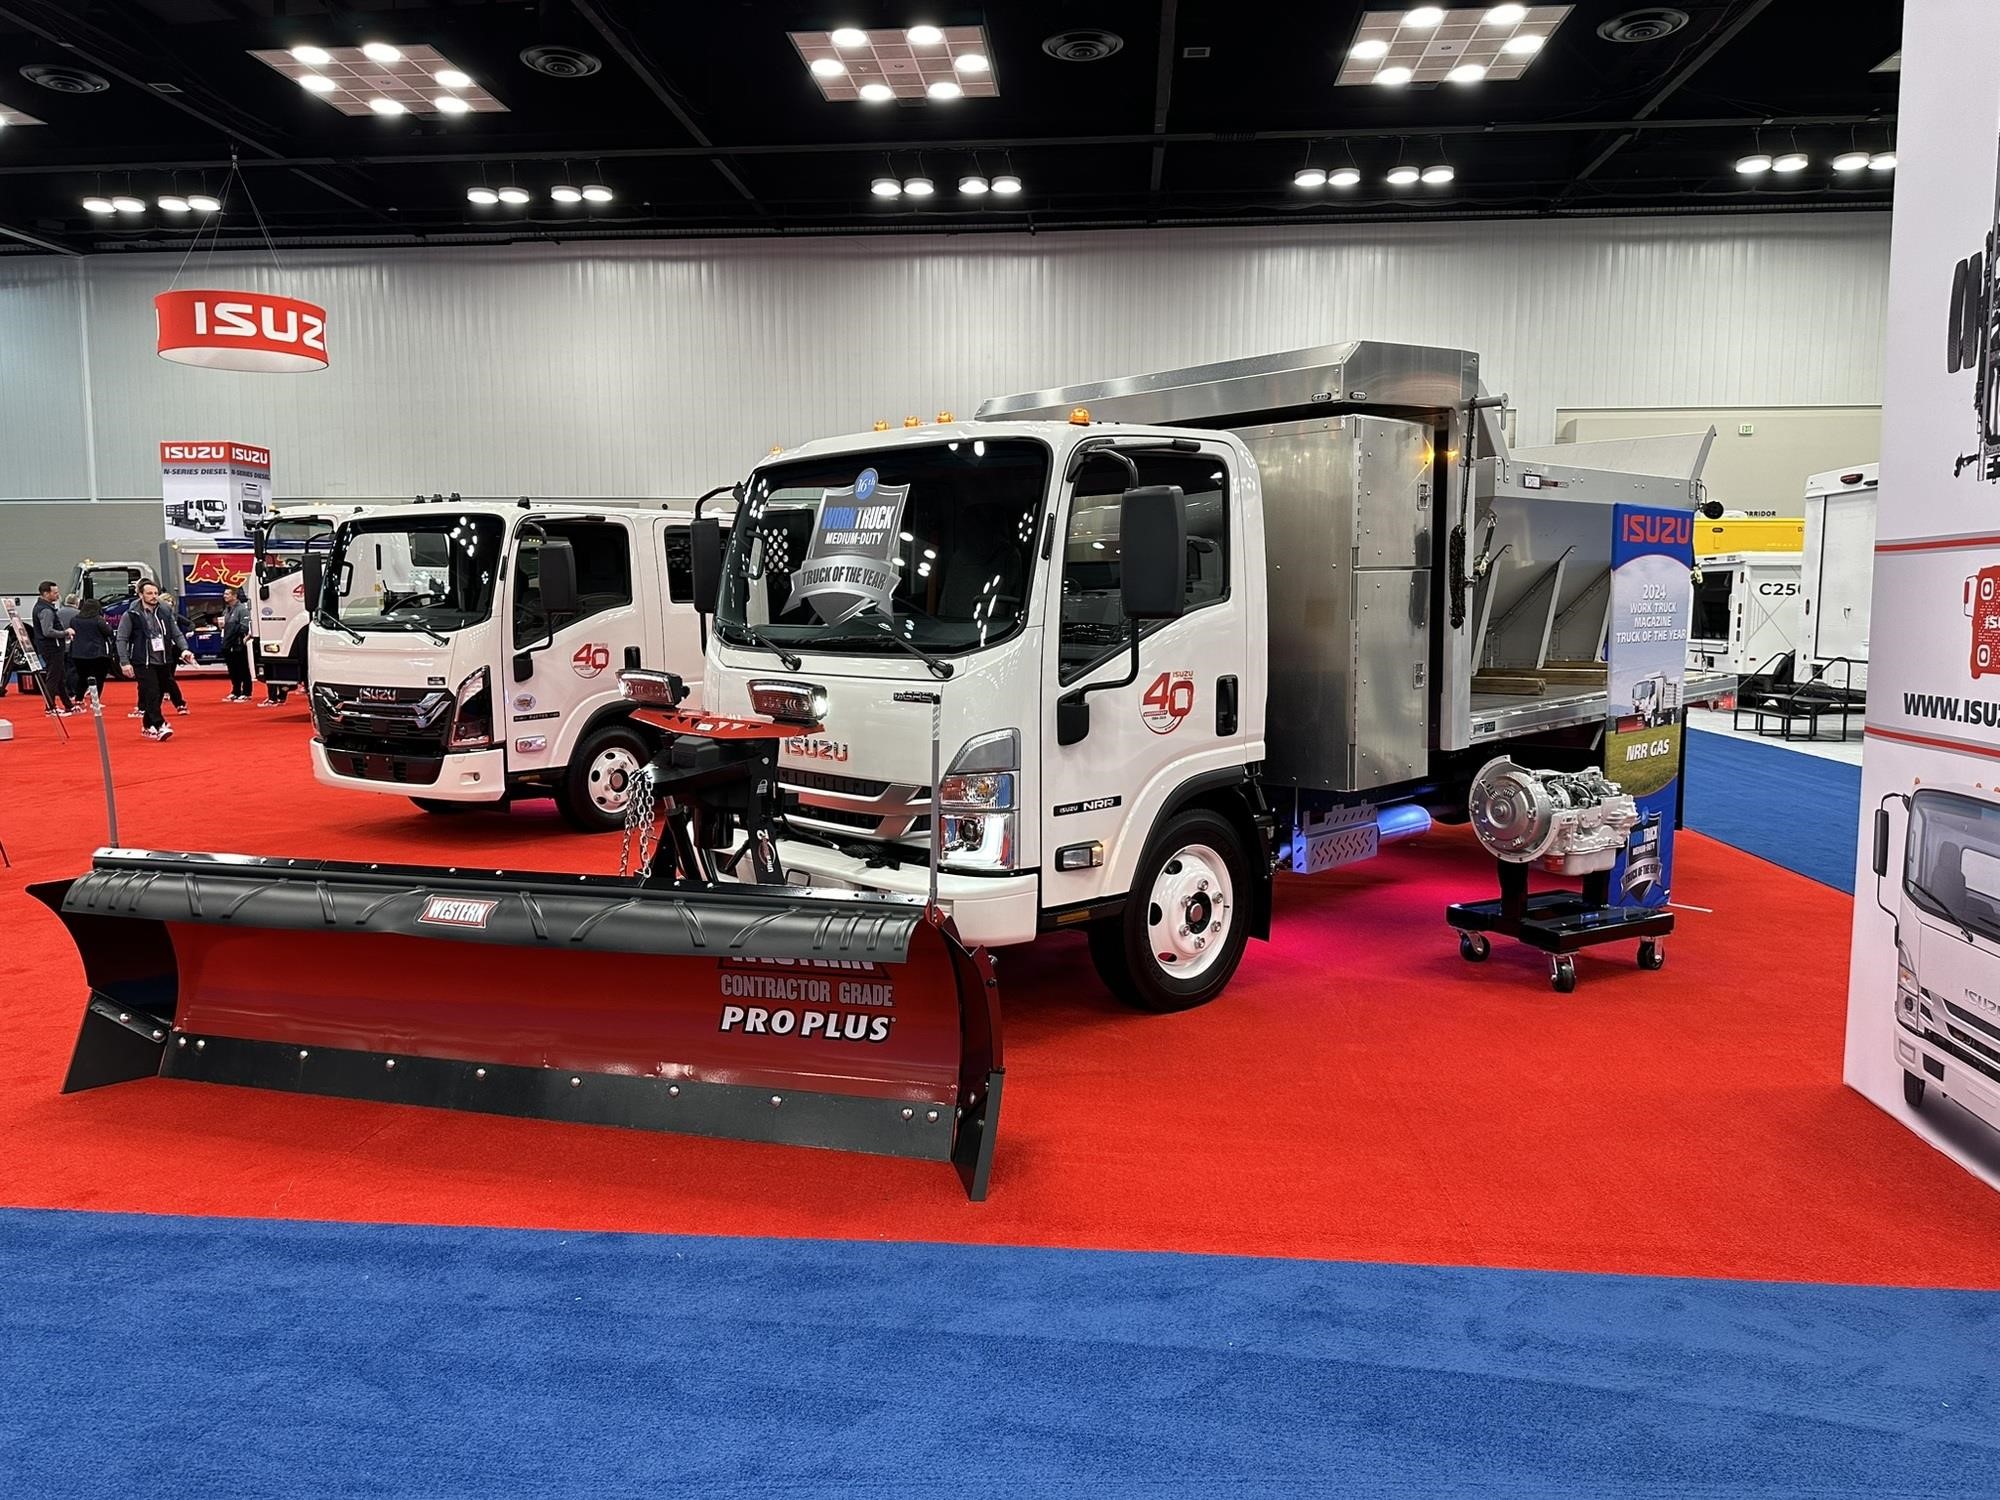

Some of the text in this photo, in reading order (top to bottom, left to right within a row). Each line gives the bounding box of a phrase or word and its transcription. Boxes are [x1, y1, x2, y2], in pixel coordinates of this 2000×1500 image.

[194, 301, 327, 351] ISUZ
[165, 446, 224, 459] ISUZU
[231, 447, 268, 464] ISUZU
[857, 478, 876, 493] 16th
[1623, 514, 1690, 544] ISUZU
[824, 532, 884, 545] MEDIUM-DUTY
[802, 565, 888, 590] TRUCK OF THE YEAR
[1642, 584, 1667, 601] 2024
[1759, 583, 1800, 596] C25
[1630, 602, 1677, 614] WORK TRUCK
[1634, 616, 1672, 628] MAGAZINE
[1985, 615, 2000, 629] IS
[1616, 628, 1687, 644] TRUCK OF THE YEAR
[573, 643, 609, 669] 40
[360, 687, 397, 701] ISUZU
[1143, 671, 1194, 718] 40
[1903, 692, 2000, 728] WWW.ISU
[784, 737, 848, 761] ISUZU
[1626, 738, 1670, 762] NRR GAS
[1059, 798, 1114, 813] ISUZU NRR
[428, 899, 489, 922] WESTERN
[720, 974, 893, 1007] CONTRACTOR GRADE
[721, 1006, 889, 1041] PRO PLUS
